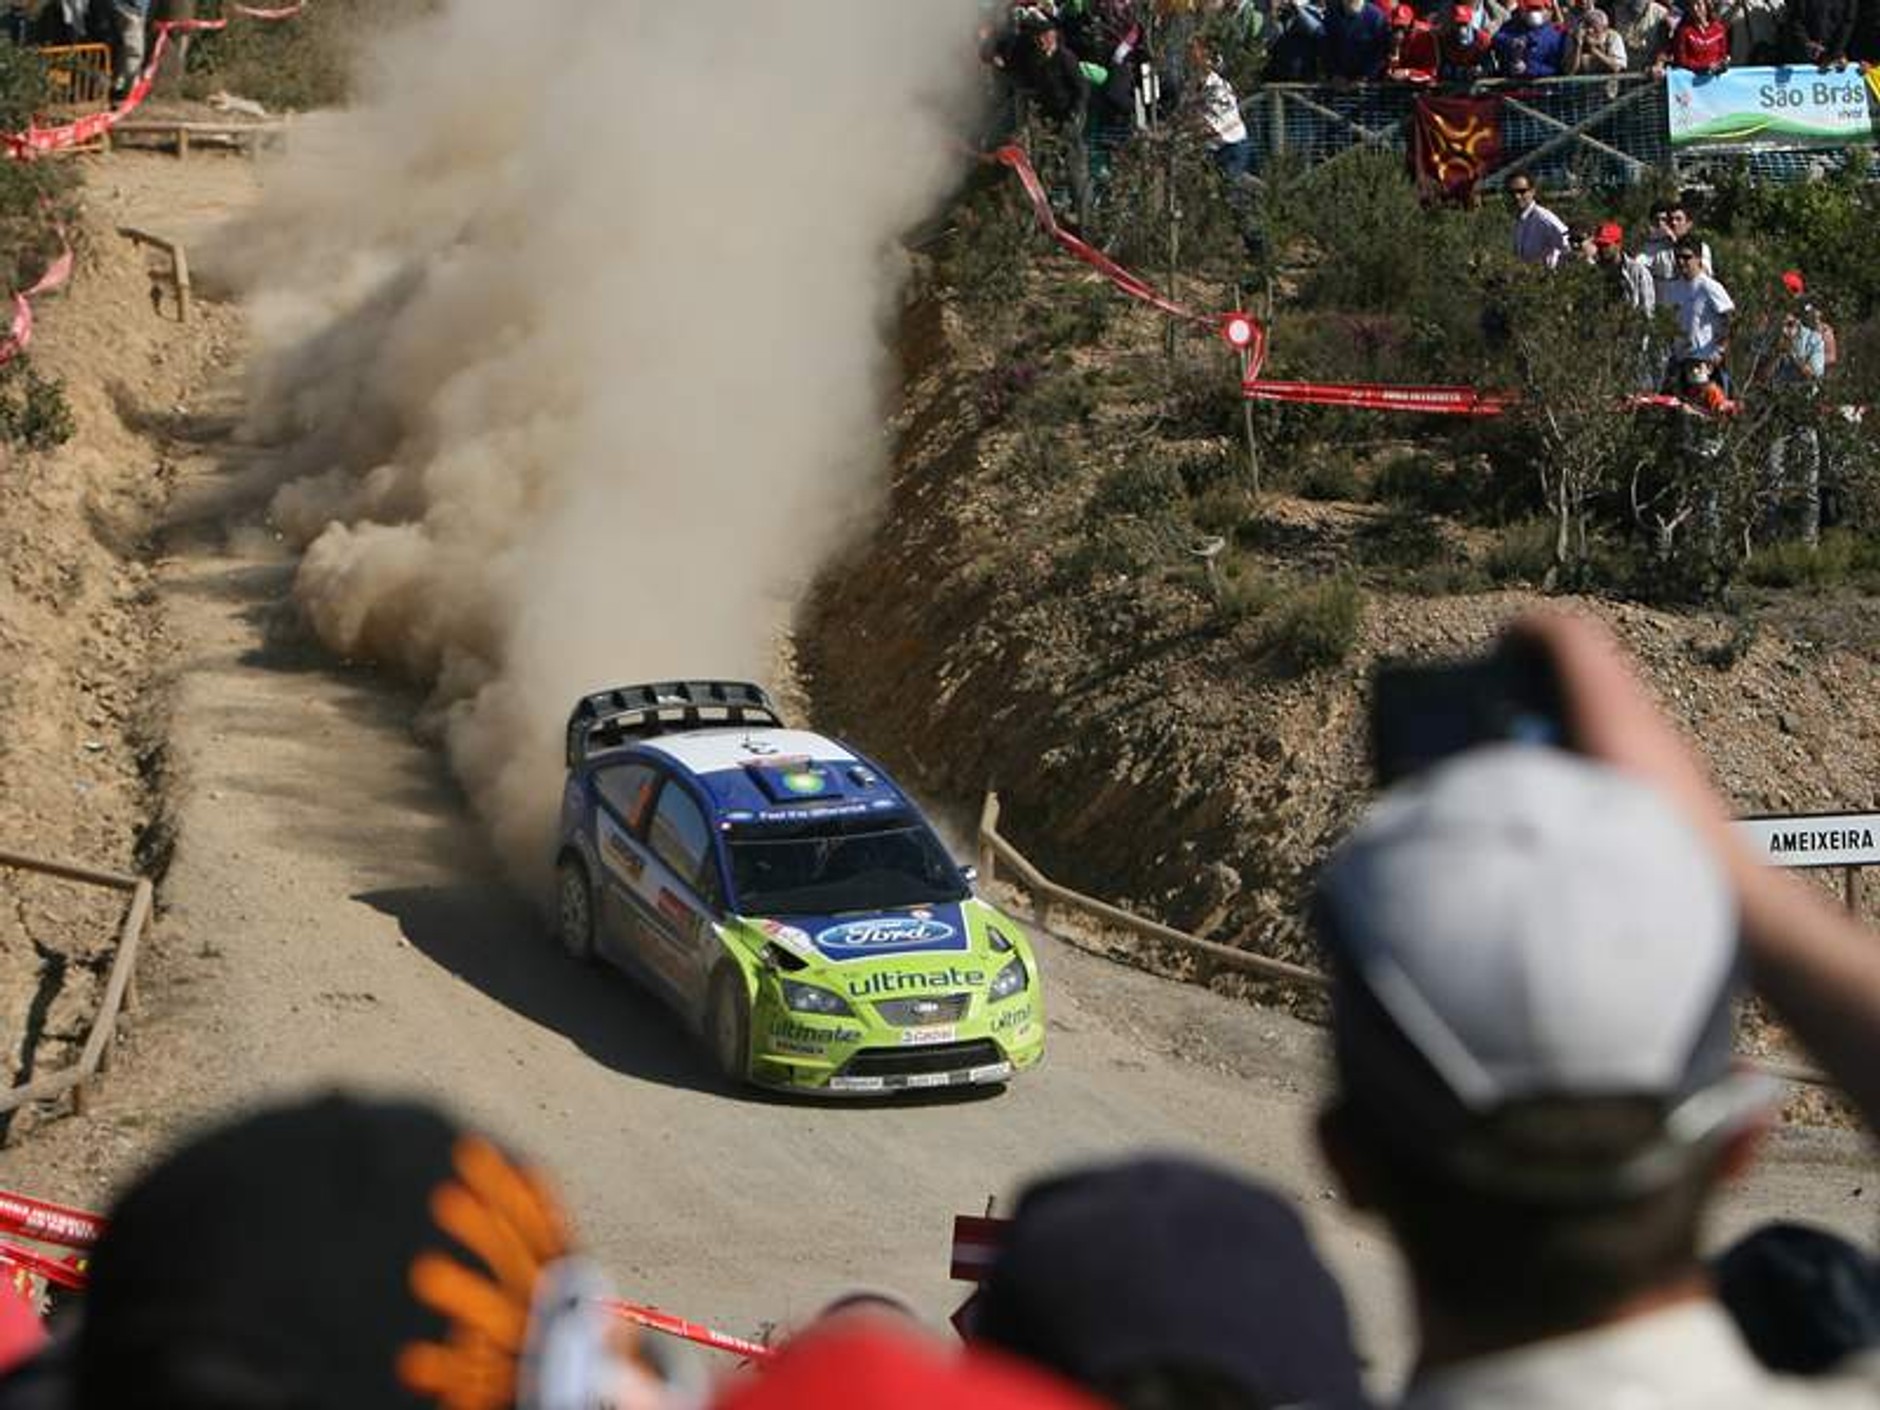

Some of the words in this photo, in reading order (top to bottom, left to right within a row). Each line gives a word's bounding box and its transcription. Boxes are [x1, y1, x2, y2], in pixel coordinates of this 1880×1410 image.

[1759, 82, 1803, 107] São
[1812, 80, 1865, 105] Brás
[1769, 829, 1874, 852] AMEIXEIRA
[845, 924, 929, 944] Ford
[848, 967, 984, 996] ultimate
[771, 1018, 861, 1042] ultimate
